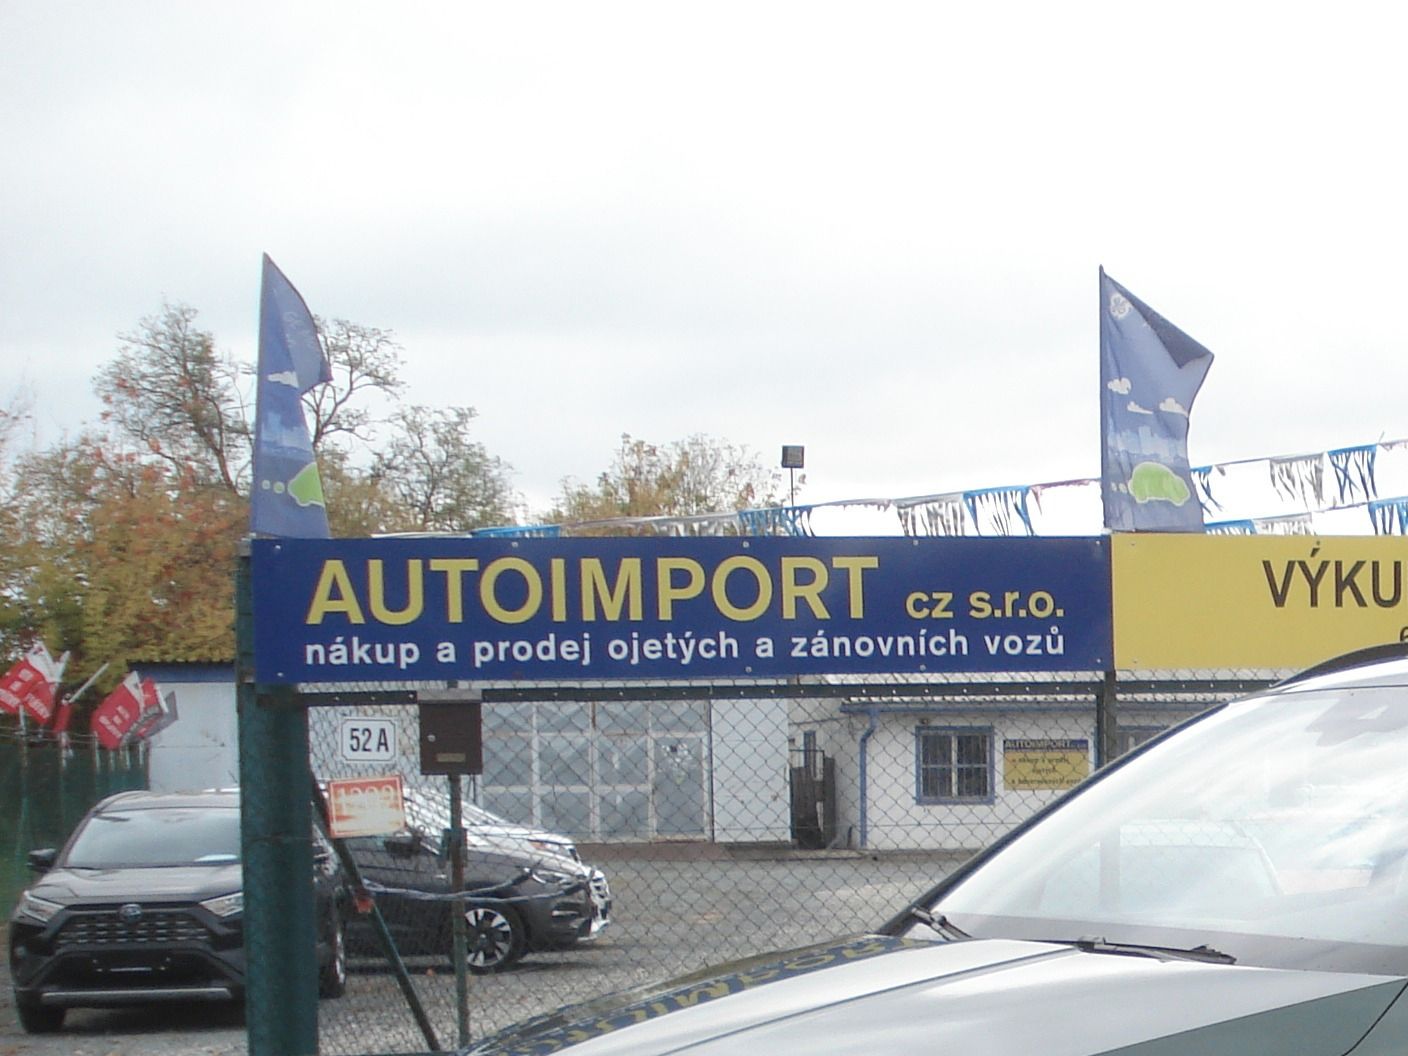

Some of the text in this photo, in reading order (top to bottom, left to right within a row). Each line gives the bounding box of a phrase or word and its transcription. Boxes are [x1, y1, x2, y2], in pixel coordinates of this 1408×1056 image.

[305, 555, 1065, 625] AUTOIMPORT cz s.r.o.
[305, 625, 1065, 669] nákup a prodej ojetých a zánovních vozů
[350, 727, 390, 752] 52 A
